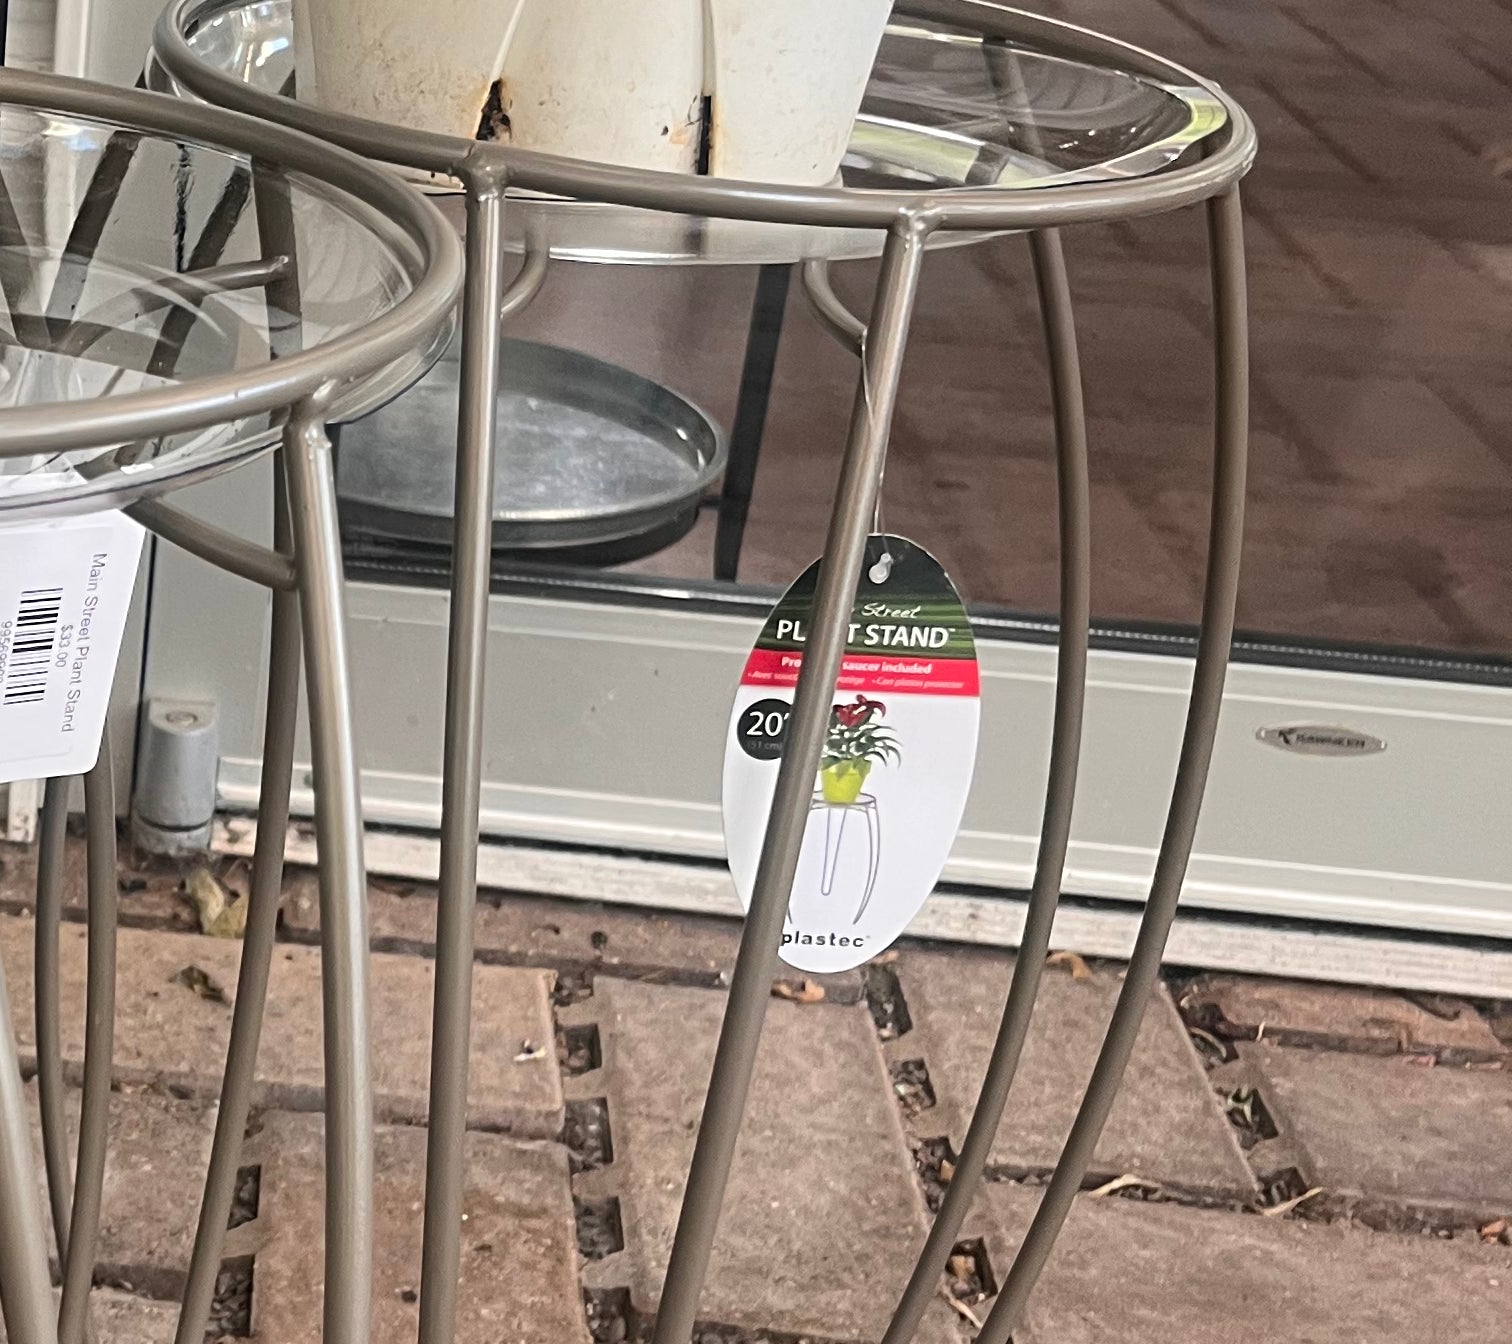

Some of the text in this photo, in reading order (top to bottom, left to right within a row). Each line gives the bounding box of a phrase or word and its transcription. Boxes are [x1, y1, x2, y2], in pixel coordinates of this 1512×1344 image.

[861, 603, 921, 619] Street
[776, 620, 861, 644] PLT
[55, 624, 74, 668] $33.00
[61, 553, 107, 732] Main Street Plant Stand
[842, 661, 932, 674] saucer included
[781, 930, 864, 947] plastec
